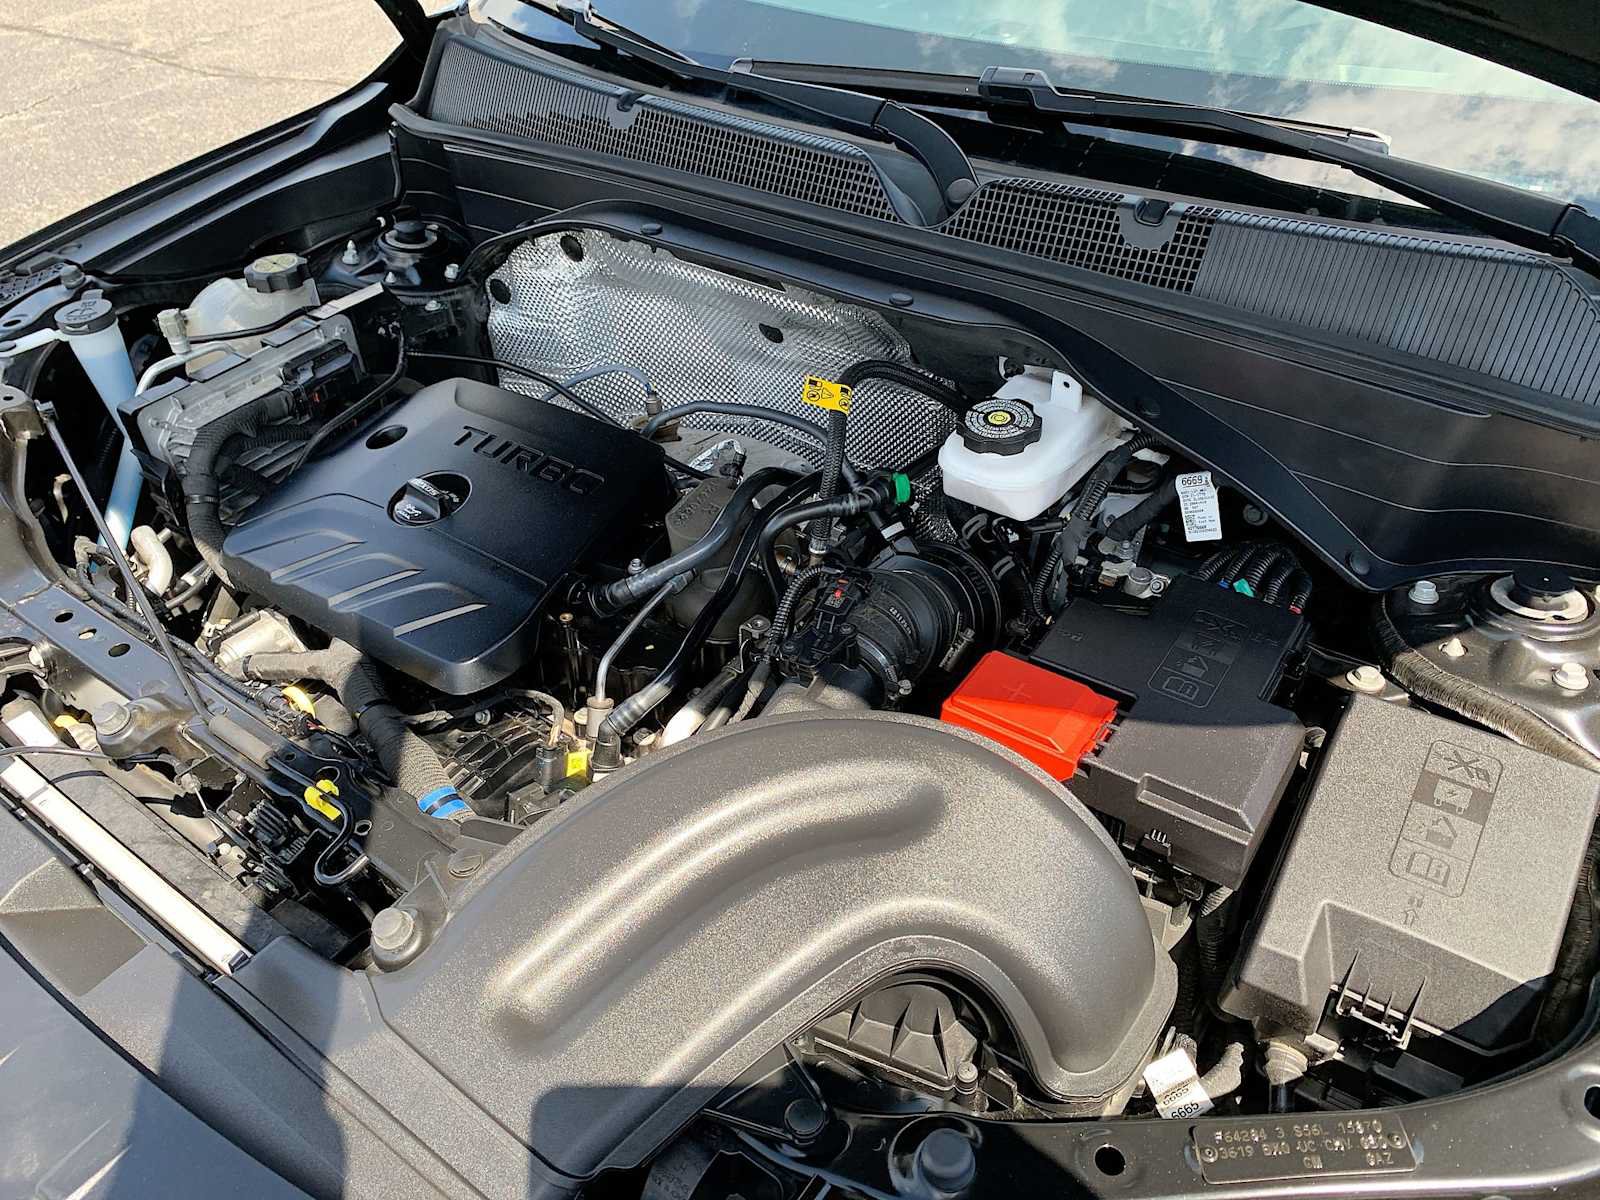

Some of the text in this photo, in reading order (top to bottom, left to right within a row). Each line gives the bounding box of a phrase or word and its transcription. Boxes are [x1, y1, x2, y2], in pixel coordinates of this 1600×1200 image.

[454, 425, 605, 495] TURBO
[1181, 475, 1203, 486] 6669
[1171, 1101, 1199, 1119] 6665
